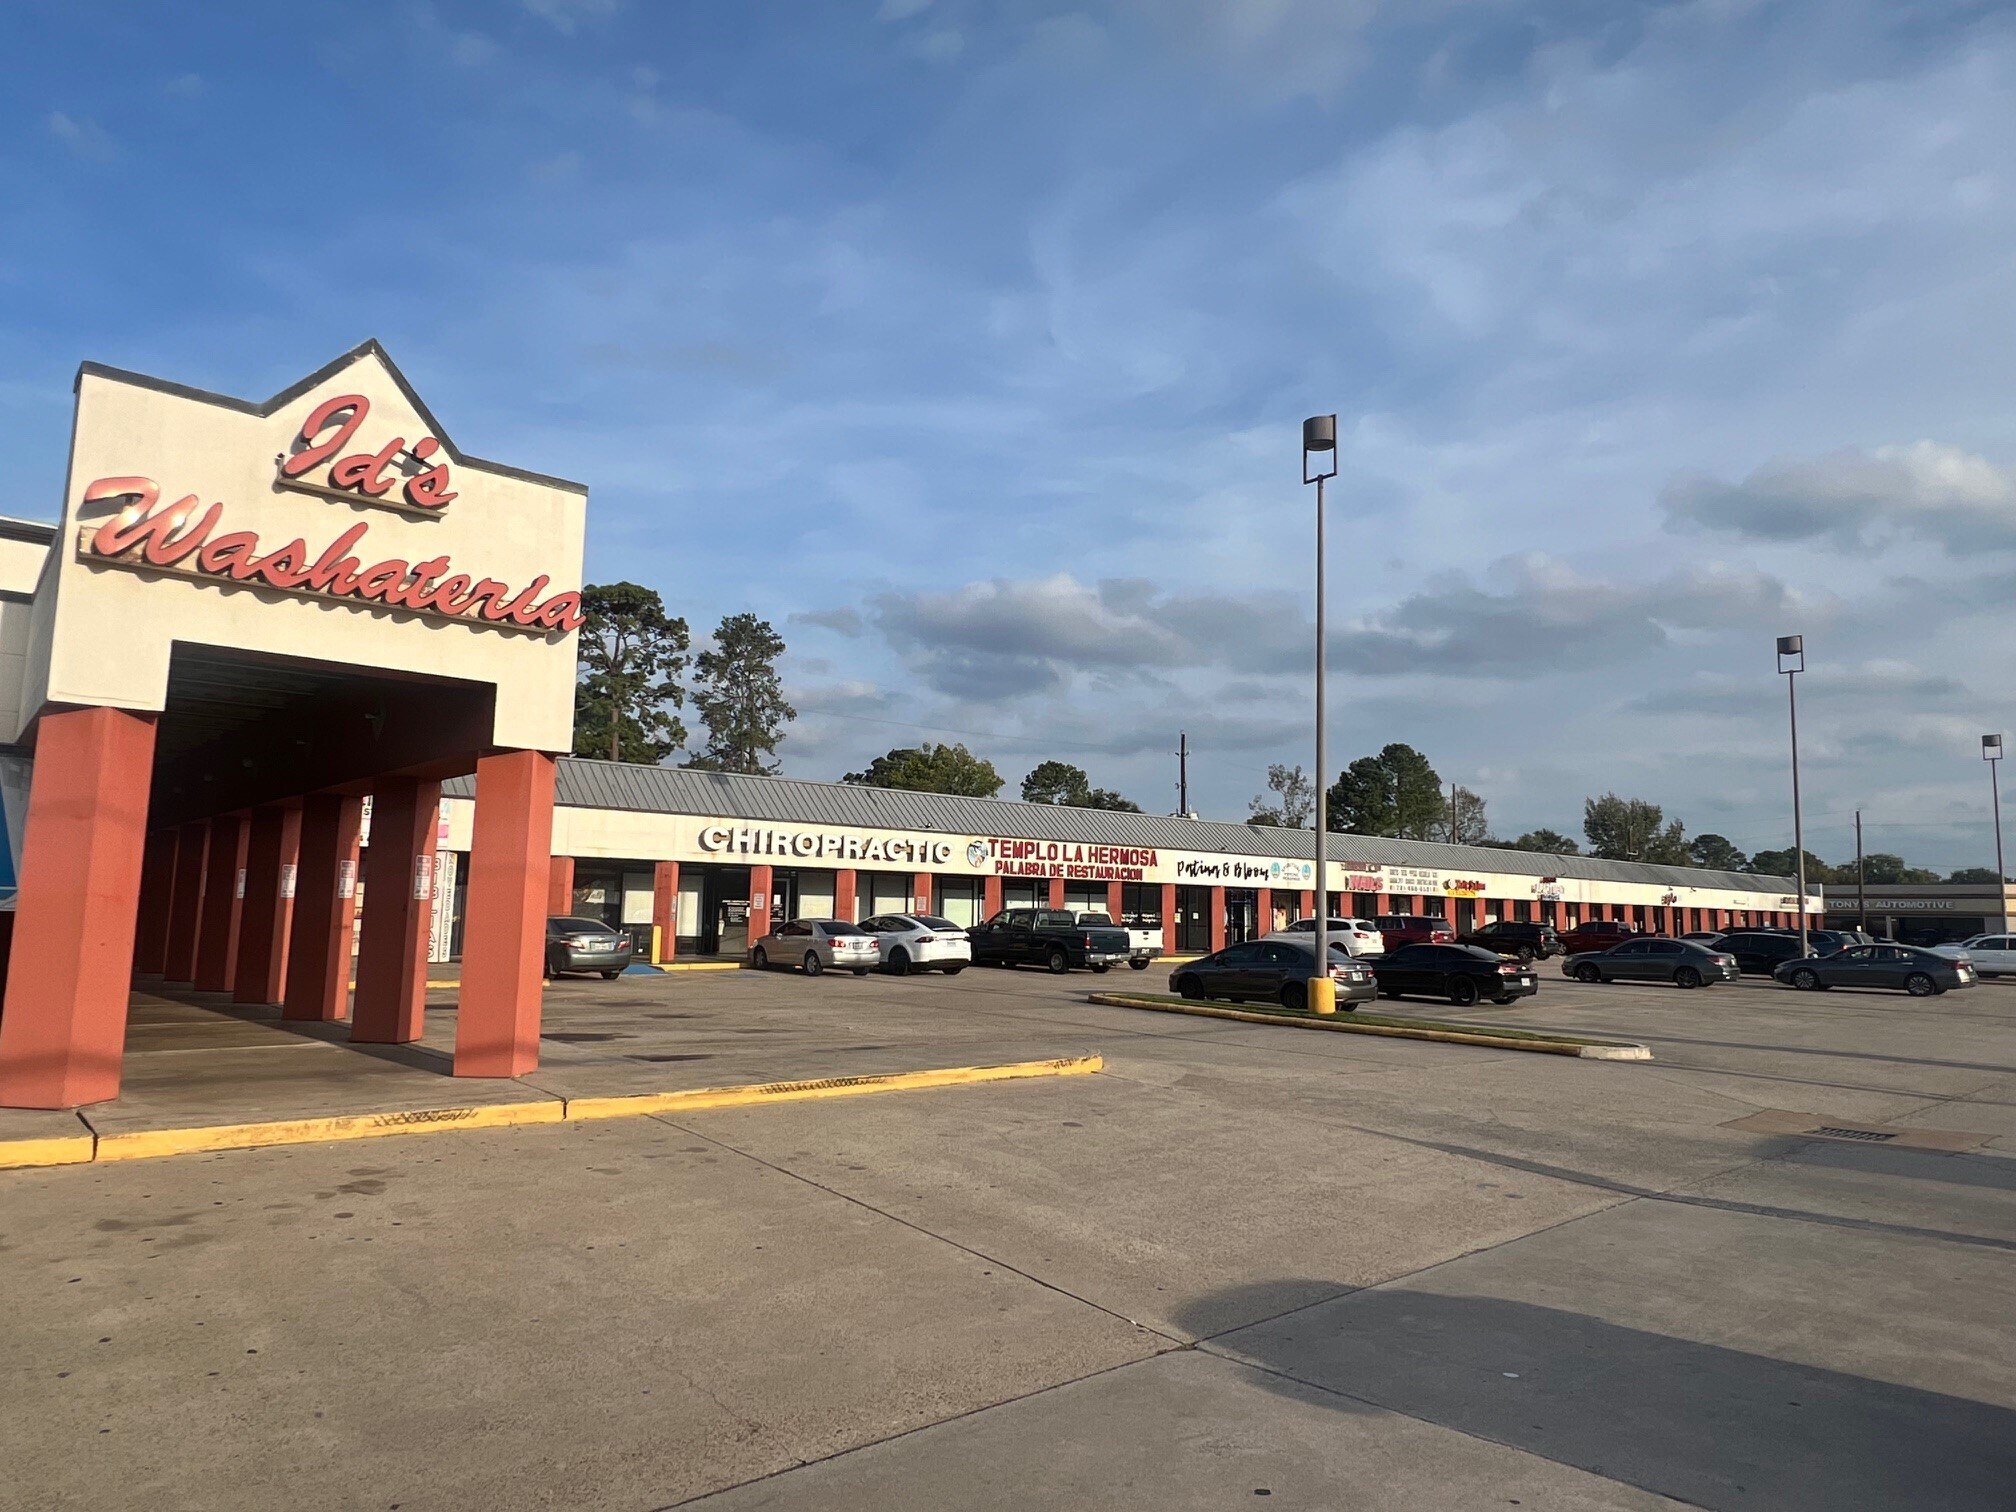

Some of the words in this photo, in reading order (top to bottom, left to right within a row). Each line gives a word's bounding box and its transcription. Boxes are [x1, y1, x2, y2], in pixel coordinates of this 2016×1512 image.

[85, 476, 585, 630] Washateria
[699, 825, 955, 864] CHIROPRACTIC
[988, 838, 1059, 862] TEMPLO
[1062, 844, 1084, 863] LA
[1088, 847, 1158, 867] HERMOSA
[995, 861, 1046, 875] PALABRA
[1049, 863, 1064, 877] DE
[1222, 862, 1230, 878] &
[1829, 900, 1870, 910] TONYS
[1875, 901, 1953, 910] AUTOMOTIVE
